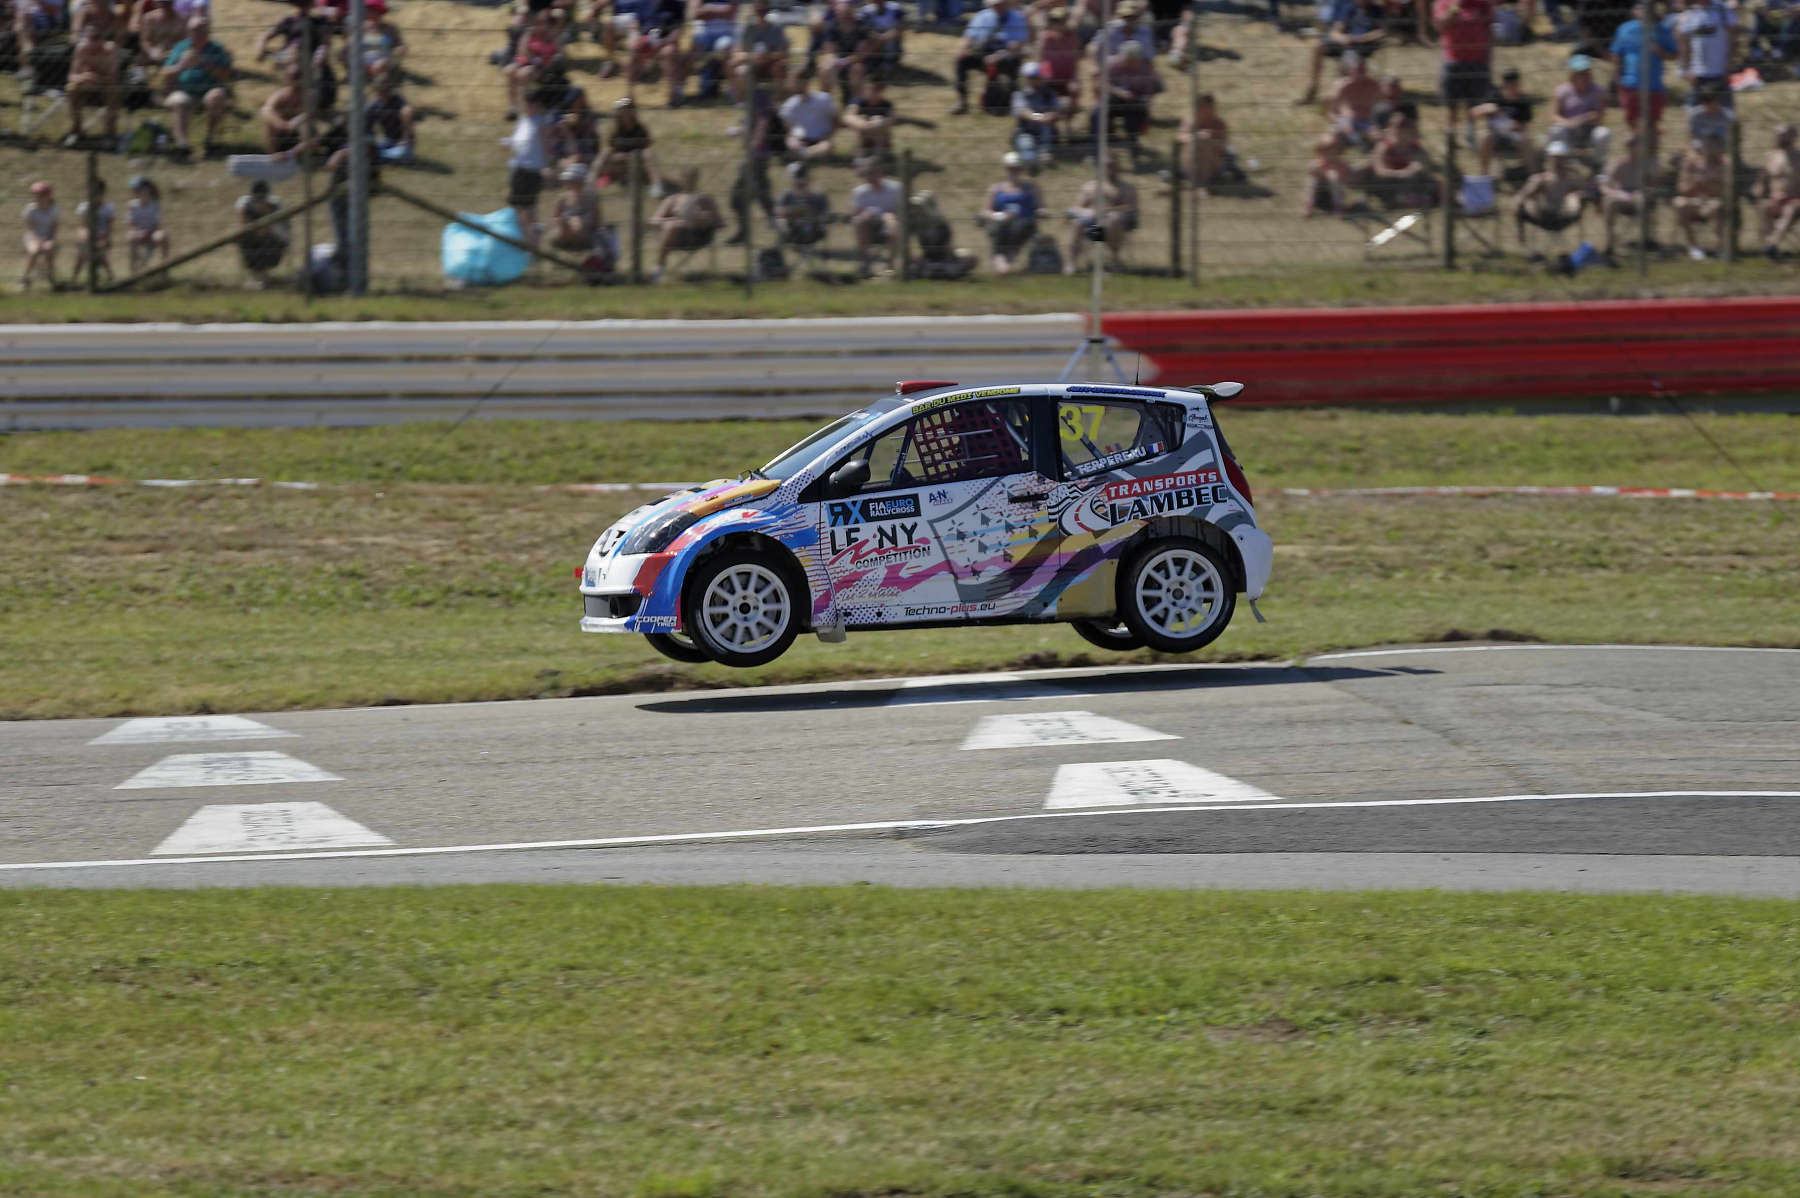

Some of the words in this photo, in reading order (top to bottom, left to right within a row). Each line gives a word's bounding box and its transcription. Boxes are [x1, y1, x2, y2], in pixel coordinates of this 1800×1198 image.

[1059, 405, 1105, 441] 37
[1108, 472, 1218, 498] TRANSPORTS
[870, 506, 915, 517] RALLYCROSS
[1109, 484, 1228, 527] LAMBEC
[855, 546, 931, 570] COMPETITION
[904, 602, 996, 616] Techno-plus.eu
